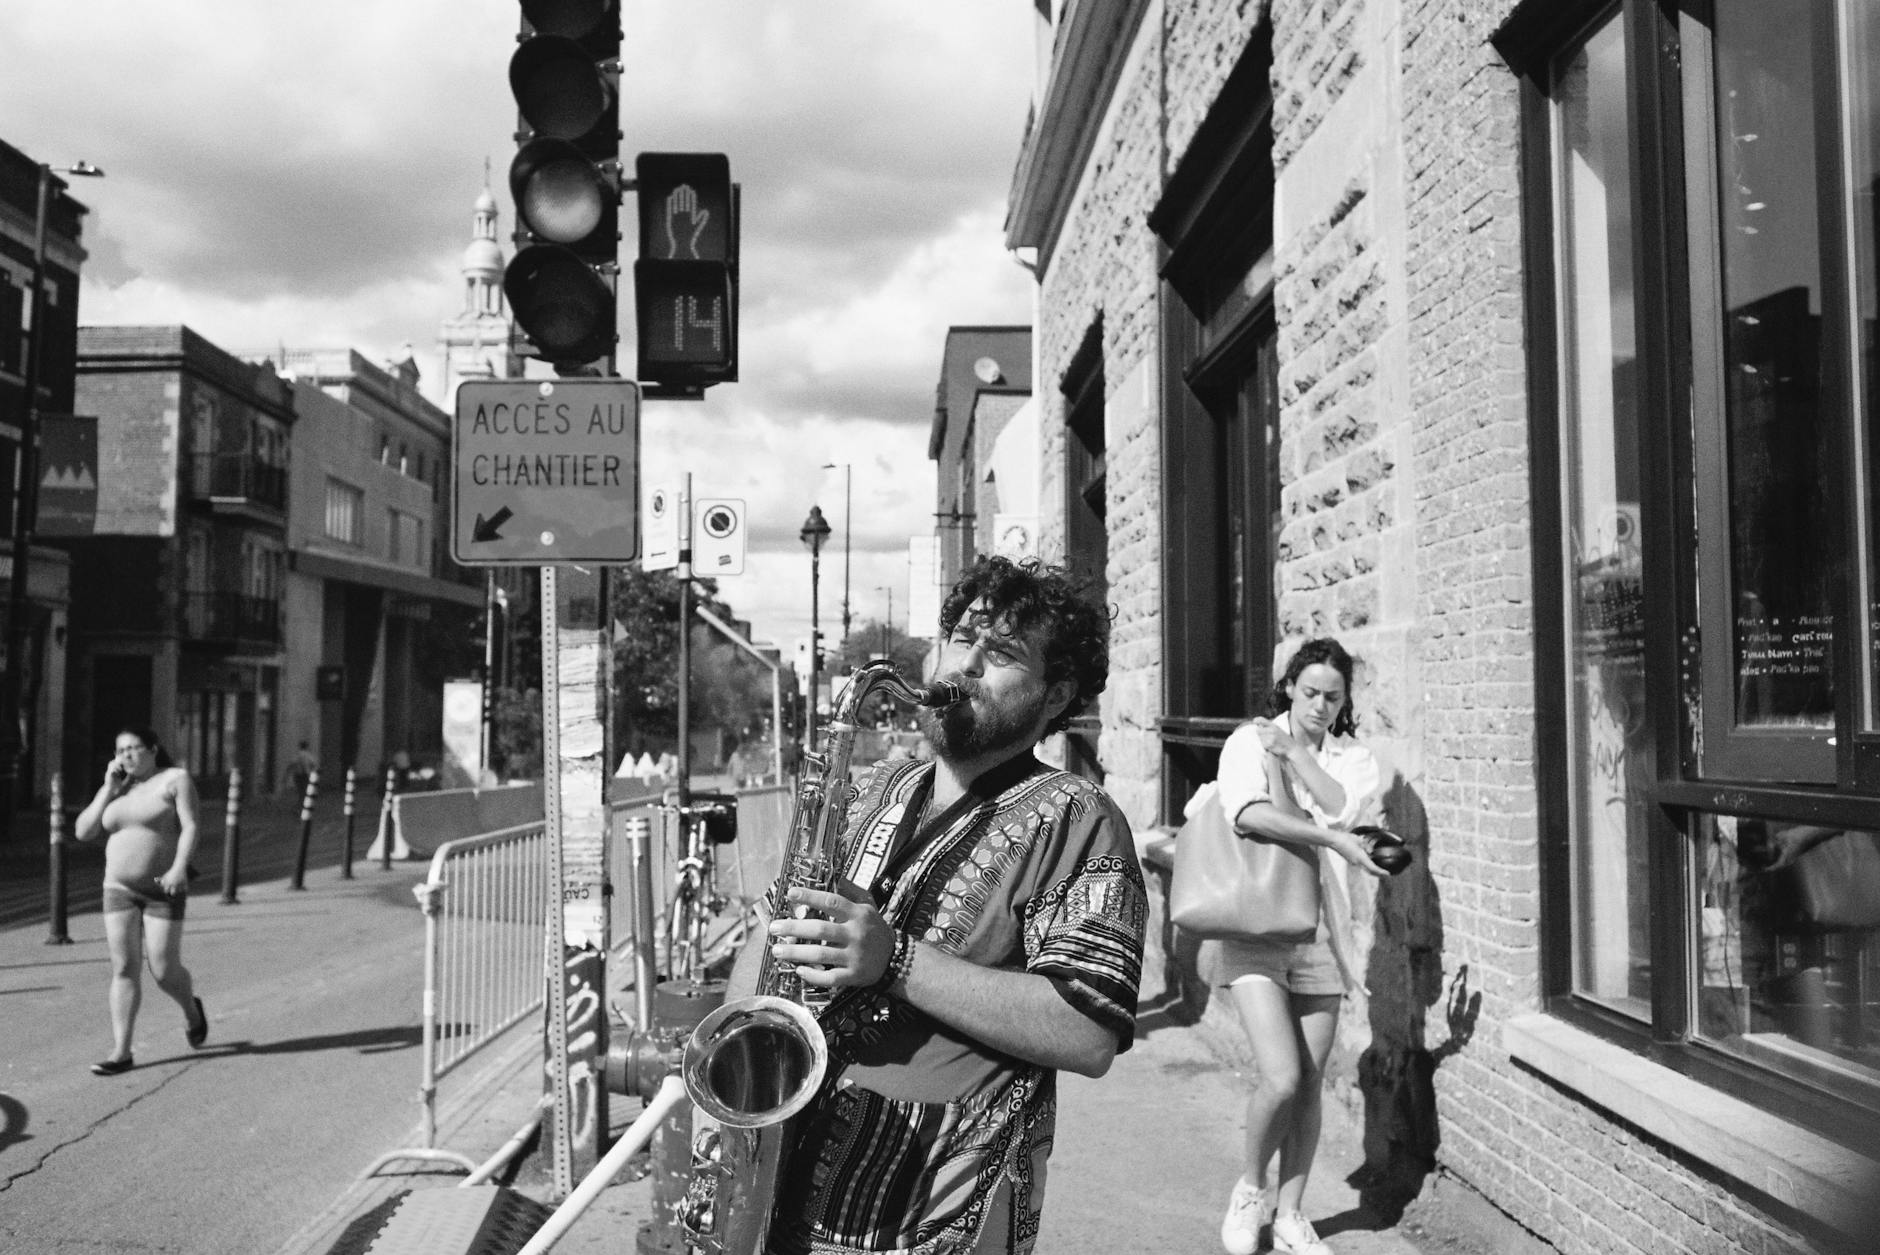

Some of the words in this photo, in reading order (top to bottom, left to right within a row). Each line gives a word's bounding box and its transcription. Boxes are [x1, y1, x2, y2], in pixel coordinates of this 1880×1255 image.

[674, 295, 721, 352] 14
[472, 397, 571, 435] ACCÈS
[587, 402, 625, 435] AU
[472, 454, 620, 487] CHANTIER
